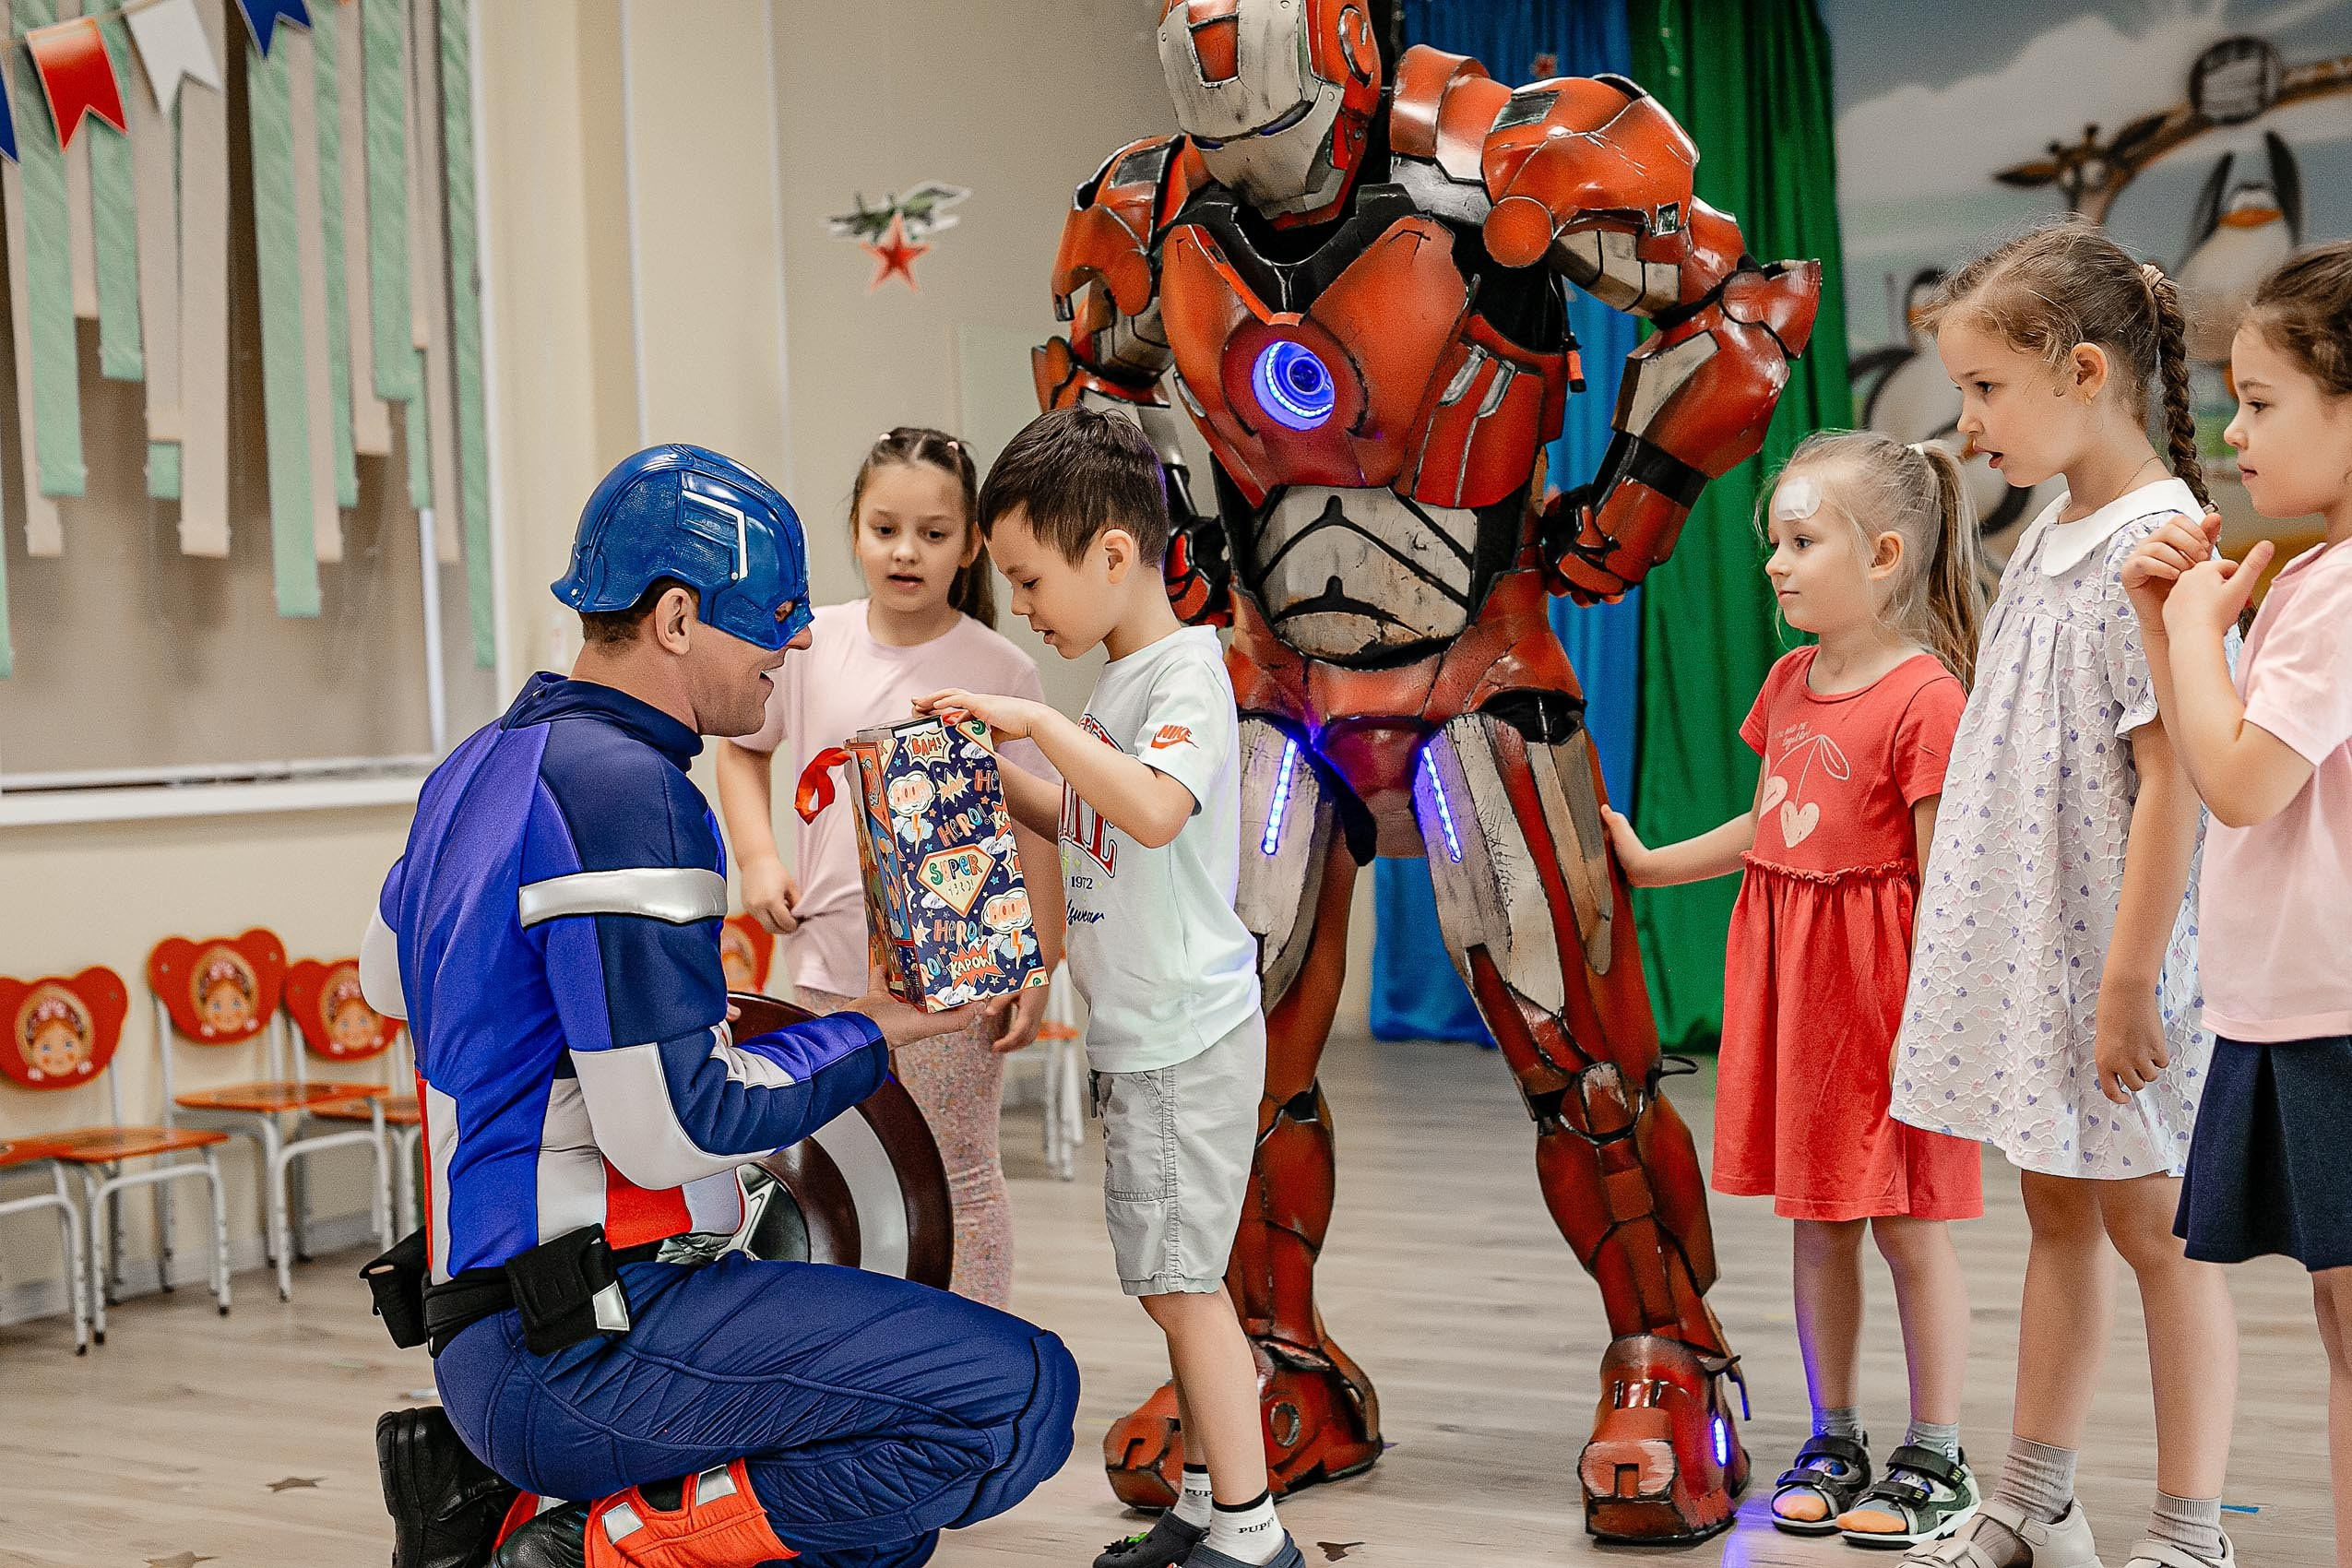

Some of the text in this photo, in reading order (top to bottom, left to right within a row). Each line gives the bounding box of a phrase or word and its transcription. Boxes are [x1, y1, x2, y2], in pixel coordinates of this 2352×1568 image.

[1157, 725, 1192, 739] NIKE
[911, 737, 943, 756] BAM!
[1071, 875, 1093, 890] 1972
[989, 896, 1031, 925] BOOM
[950, 951, 998, 980] KAPOW!
